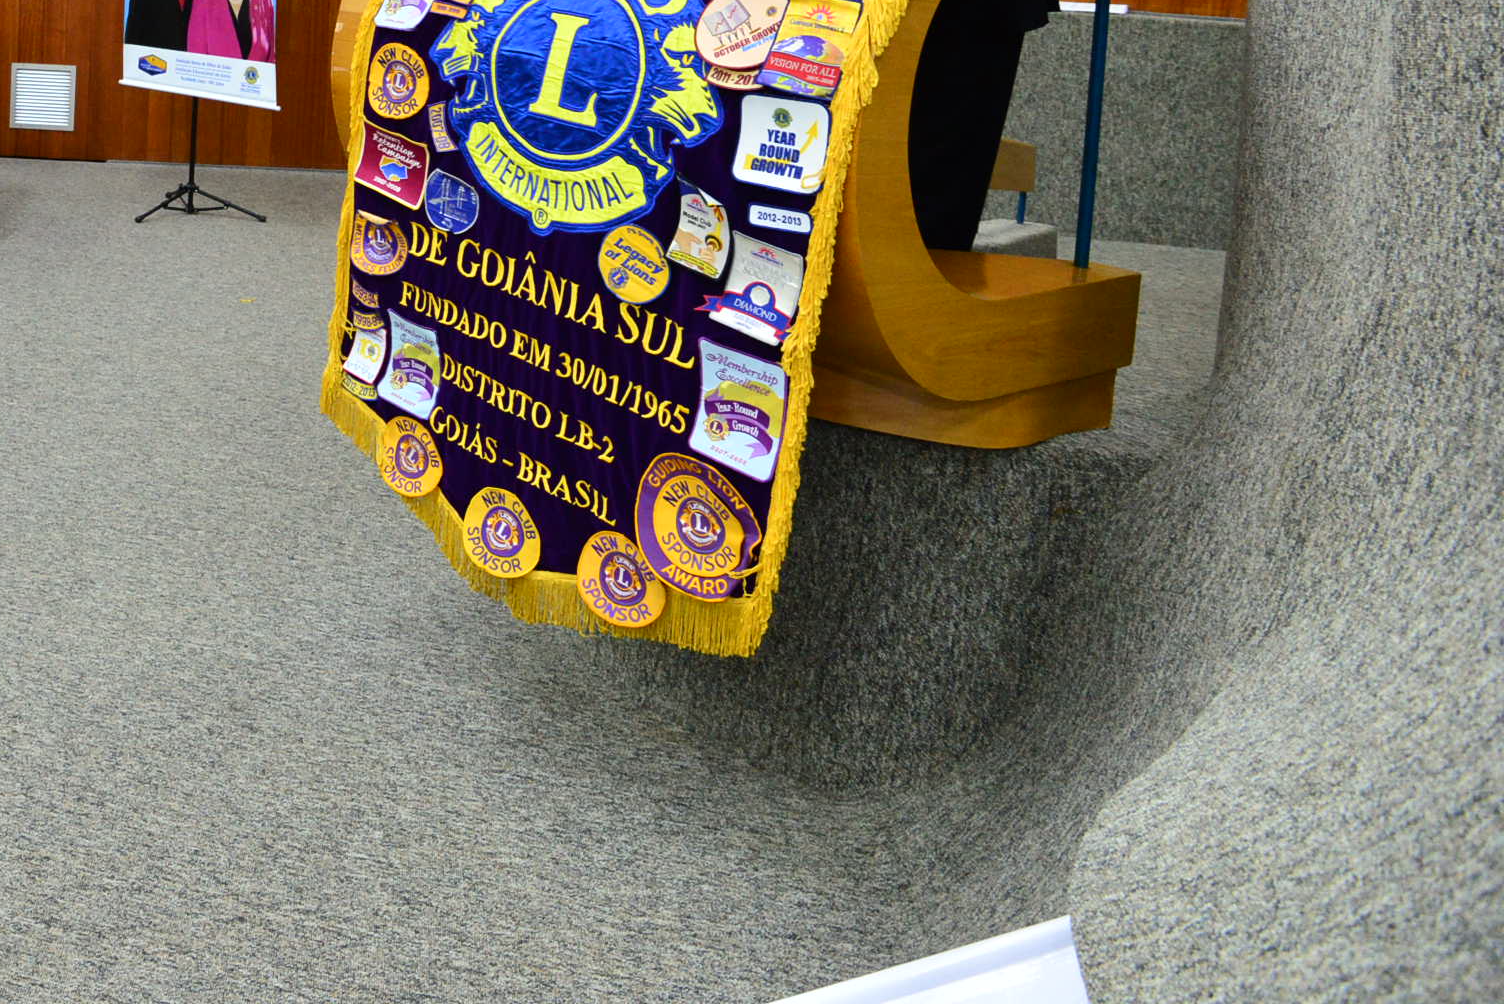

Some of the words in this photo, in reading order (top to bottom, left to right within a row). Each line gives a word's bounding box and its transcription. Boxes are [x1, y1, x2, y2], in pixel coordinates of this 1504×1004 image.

[377, 48, 397, 68] NEW
[401, 49, 425, 79] CLUB
[713, 39, 751, 59] OCTOBER
[770, 56, 798, 71] VISION
[800, 63, 818, 75] FOR
[819, 66, 837, 78] ALL
[528, 12, 598, 127] L
[372, 85, 419, 116] SPONSOR
[759, 143, 800, 163] ROUND
[767, 129, 796, 146] YEAR
[476, 134, 634, 211] INTERNATIONAL
[750, 157, 803, 179] GROWTH
[757, 211, 802, 226] 2012-2013
[604, 249, 623, 260] of
[620, 256, 657, 285] Lions
[613, 238, 665, 274] Legacy
[409, 221, 448, 266] DE
[456, 239, 607, 333] GOIÂNIA
[615, 302, 696, 369] SUL
[734, 298, 778, 322] DIAMOND
[399, 281, 507, 348] FUNDADO
[510, 329, 551, 372] EM
[556, 352, 691, 434] 30/01/1965
[706, 352, 778, 387] Membership
[715, 369, 771, 396] Excellence
[442, 353, 552, 429] DISTRITO
[556, 411, 616, 464] LB-2
[715, 402, 758, 419] Year-Round
[395, 419, 418, 434] NEW
[420, 432, 440, 468] CLUB
[731, 420, 759, 437] Growth
[430, 405, 497, 464] GOIÁS
[516, 451, 616, 527] BRASIL
[648, 459, 702, 487] GUIDING
[707, 472, 745, 510] LION
[663, 480, 690, 508] NEW
[696, 484, 730, 520] CLUB
[481, 491, 506, 507] NEW
[512, 501, 537, 540] CLUB
[467, 526, 522, 573] SPONSOR
[592, 537, 618, 557] NEW
[624, 543, 656, 582] CLUB
[661, 532, 736, 572] SPONSOR
[661, 564, 729, 595] AWARD
[583, 578, 652, 622] SPONSOR
